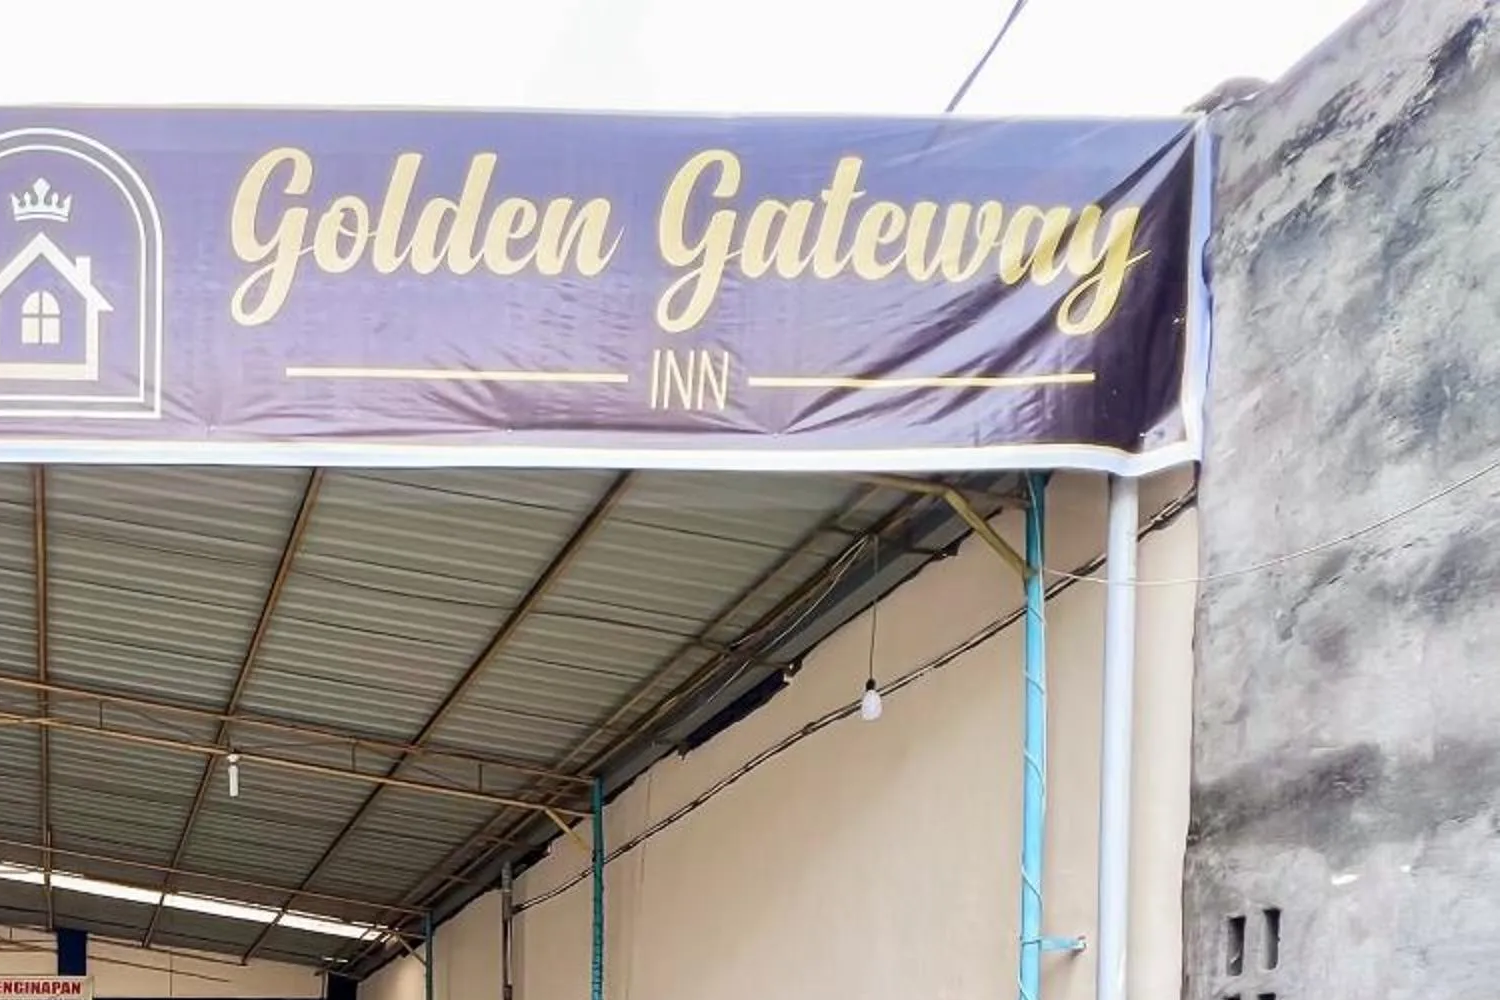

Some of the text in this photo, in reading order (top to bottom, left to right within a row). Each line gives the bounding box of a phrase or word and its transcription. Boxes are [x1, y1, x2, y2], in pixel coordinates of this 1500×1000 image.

[229, 146, 1152, 336] Golden Gateway
[650, 349, 731, 412] INN
